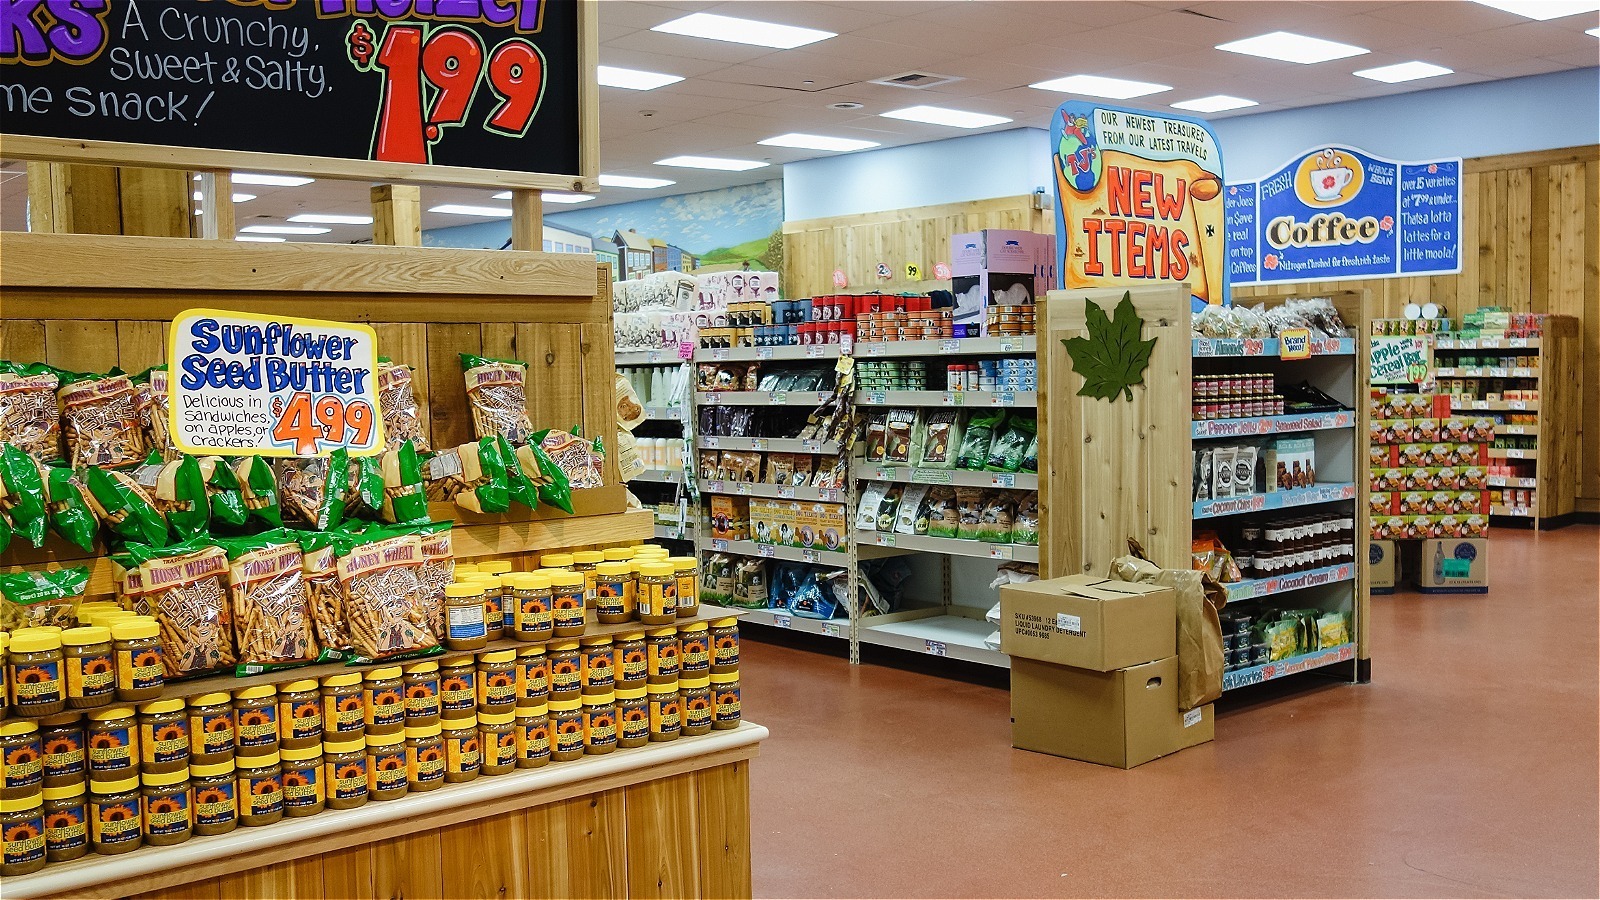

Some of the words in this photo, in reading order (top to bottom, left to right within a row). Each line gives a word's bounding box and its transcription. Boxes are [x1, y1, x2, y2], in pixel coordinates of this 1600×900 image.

[122, 0, 149, 41] A
[110, 47, 218, 84] Sweet
[69, 84, 216, 127] snack!
[1101, 112, 1118, 126] OUR
[1125, 116, 1156, 132] NEWEST
[1163, 121, 1205, 143] TREASURES
[1103, 131, 1125, 145] FROM
[1129, 135, 1145, 148] OUR
[1149, 138, 1174, 152] LATEST
[1177, 141, 1208, 161] TRAVELS
[1368, 163, 1395, 176] WHOLE
[1260, 171, 1293, 201] FRESH
[1370, 174, 1394, 186] BEAN
[1425, 176, 1456, 188] varieties
[1107, 166, 1187, 221] NEW
[1431, 210, 1452, 223] lotta
[1233, 228, 1249, 241] real
[1268, 214, 1377, 247] Coffee
[1404, 229, 1429, 243] lattes
[1430, 228, 1441, 241] for
[1444, 230, 1450, 241] a
[1083, 218, 1190, 281] ITEMS
[1231, 248, 1240, 257] on
[1240, 246, 1253, 258] top
[1404, 247, 1424, 261] little
[1425, 244, 1457, 259] moola!
[191, 318, 358, 361] Sunflower
[1284, 336, 1306, 345] Brand
[181, 354, 263, 392] Seed
[266, 357, 370, 395] Butter
[183, 394, 244, 408] Delicious
[248, 394, 262, 409] in
[184, 410, 271, 424] sandwiches,
[184, 424, 204, 434] on
[346, 551, 381, 573] HONEY
[382, 545, 416, 563] WHEAT
[149, 564, 183, 585] HONEY
[184, 554, 224, 578] WHEAT
[1280, 574, 1308, 590] Coconut
[1014, 613, 1026, 621] SKU
[1015, 620, 1032, 629] LIQUID
[1032, 623, 1056, 633] LAUNDRY
